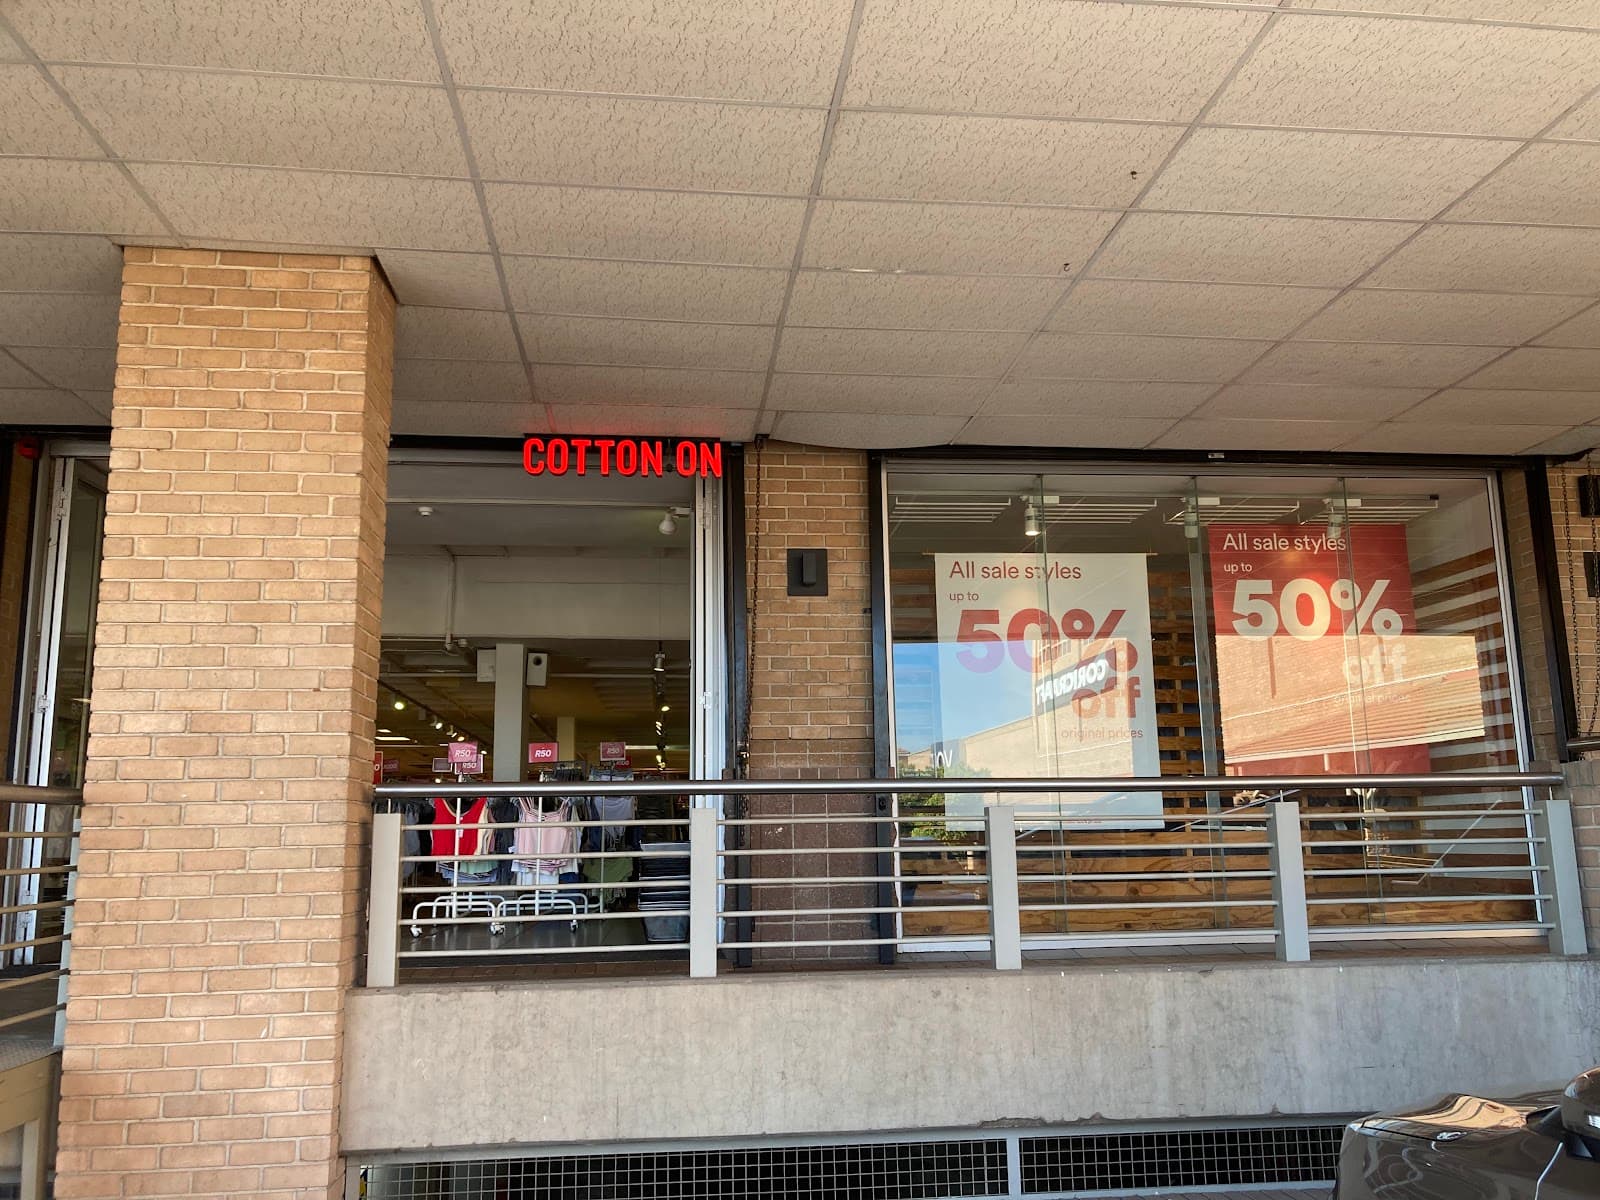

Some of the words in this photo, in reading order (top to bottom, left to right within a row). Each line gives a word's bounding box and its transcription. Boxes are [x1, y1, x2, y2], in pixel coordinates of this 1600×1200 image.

[523, 438, 663, 477] COTTON
[676, 440, 722, 478] ON
[1223, 532, 1247, 551] All
[1253, 533, 1289, 551] sale
[1293, 533, 1347, 555] styles
[948, 560, 975, 579] All
[981, 561, 1019, 579] sale
[1223, 562, 1239, 573] up
[1241, 561, 1253, 572] to
[949, 592, 965, 602] up
[967, 591, 979, 602] to
[1231, 578, 1404, 642] 50%
[955, 608, 1139, 674] 50%
[1342, 643, 1407, 685] off
[1071, 676, 1142, 719] off
[454, 749, 471, 758] R50
[534, 749, 552, 758] R50
